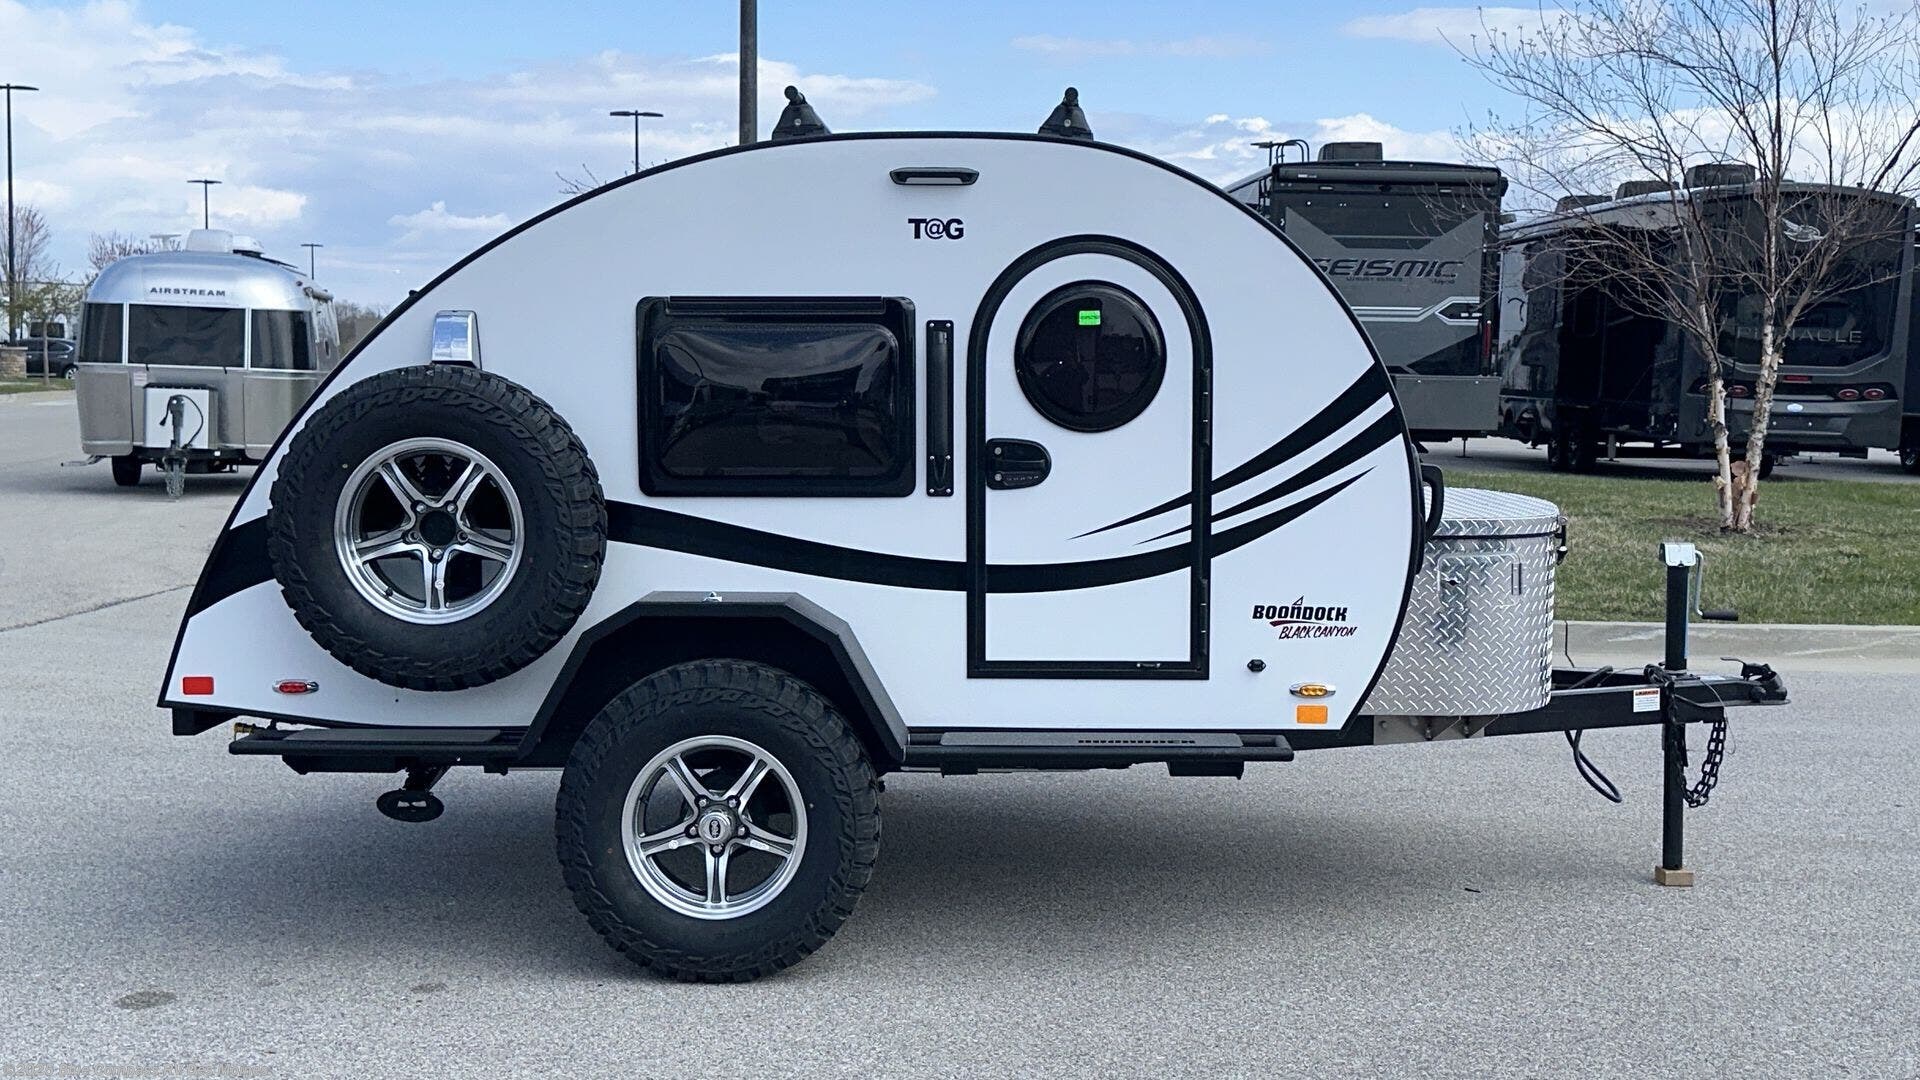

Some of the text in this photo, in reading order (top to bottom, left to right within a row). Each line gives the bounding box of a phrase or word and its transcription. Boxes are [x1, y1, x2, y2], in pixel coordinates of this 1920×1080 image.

[908, 219, 964, 240] T@G
[150, 287, 225, 296] AIRSTREAM
[1737, 327, 1862, 343] PINACLE
[1252, 605, 1348, 621] BOONDOCK
[1279, 625, 1358, 640] BLACK CANYON
